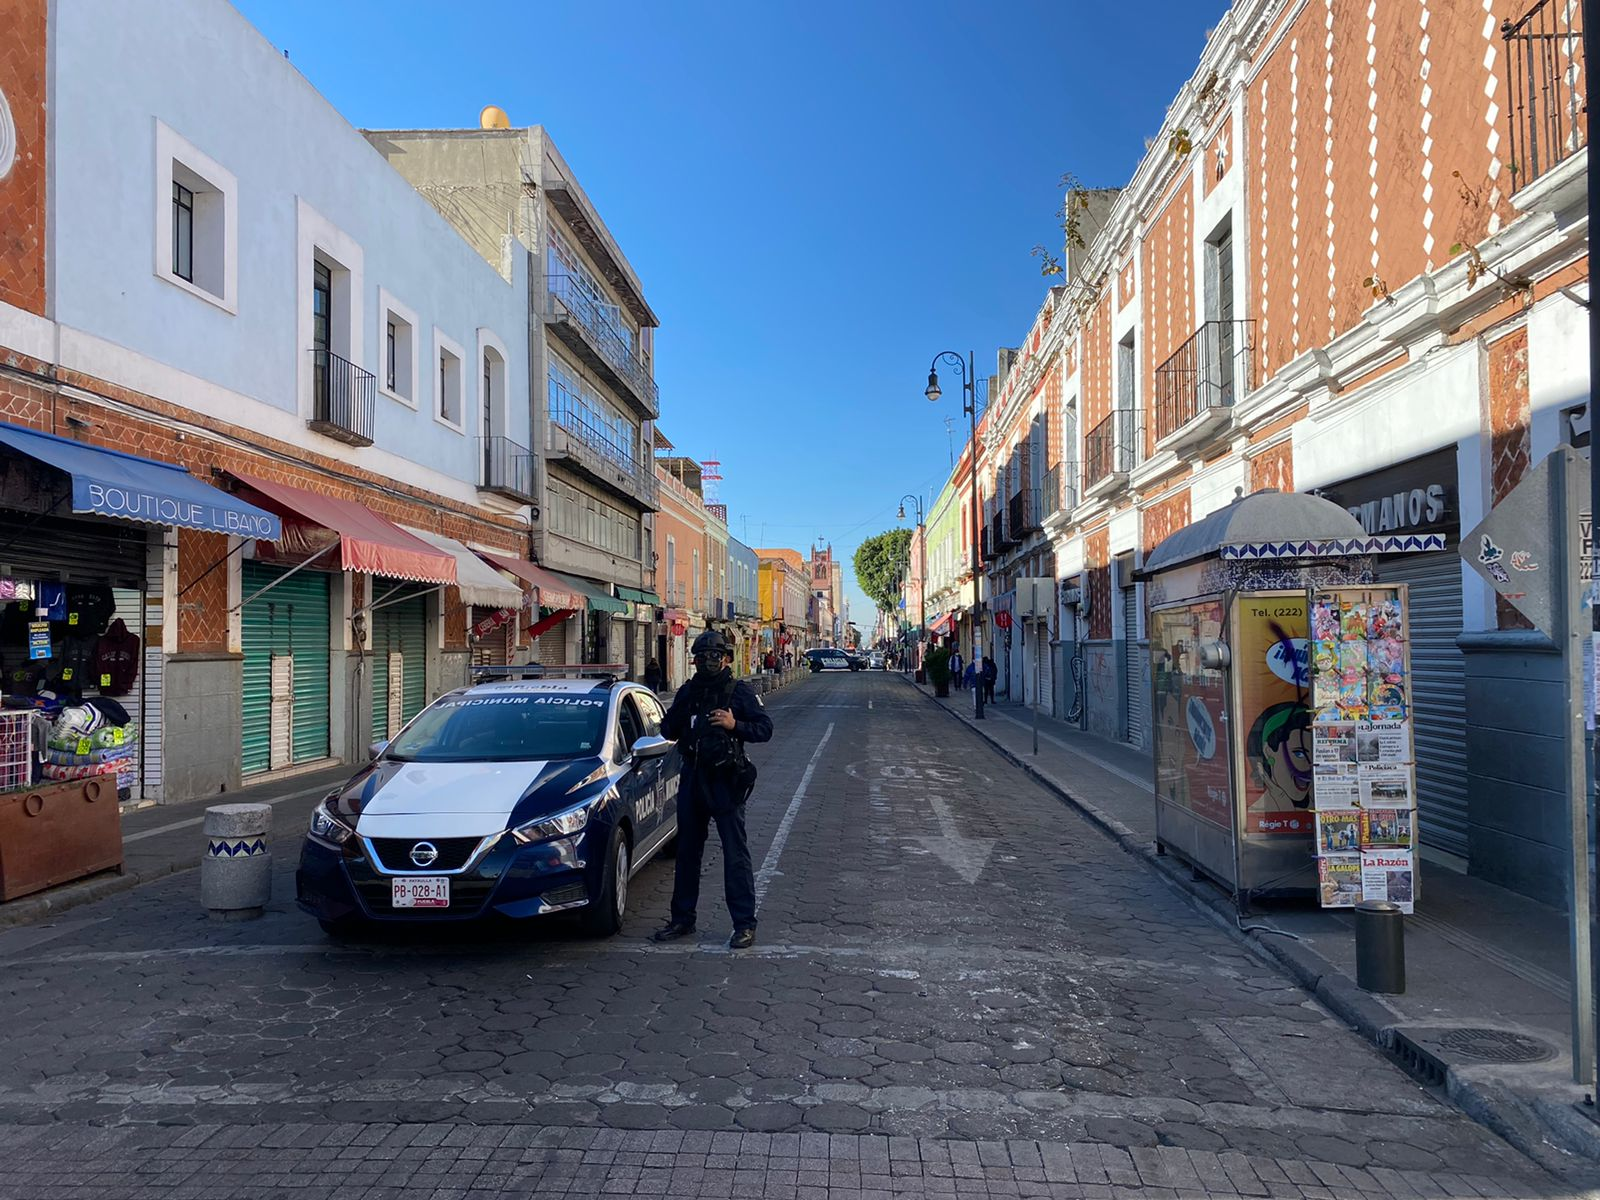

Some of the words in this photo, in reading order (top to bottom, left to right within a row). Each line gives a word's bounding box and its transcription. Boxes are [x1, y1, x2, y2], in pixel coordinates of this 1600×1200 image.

[88, 484, 203, 524] BOUTIQUE
[212, 508, 272, 535] LIBANO
[1251, 608, 1271, 617] Tel.
[1273, 608, 1303, 618] (222)
[1320, 815, 1340, 824] OTRO
[1363, 858, 1375, 866] La
[1377, 857, 1408, 866] Razón
[394, 884, 446, 898] PB-028-A1
